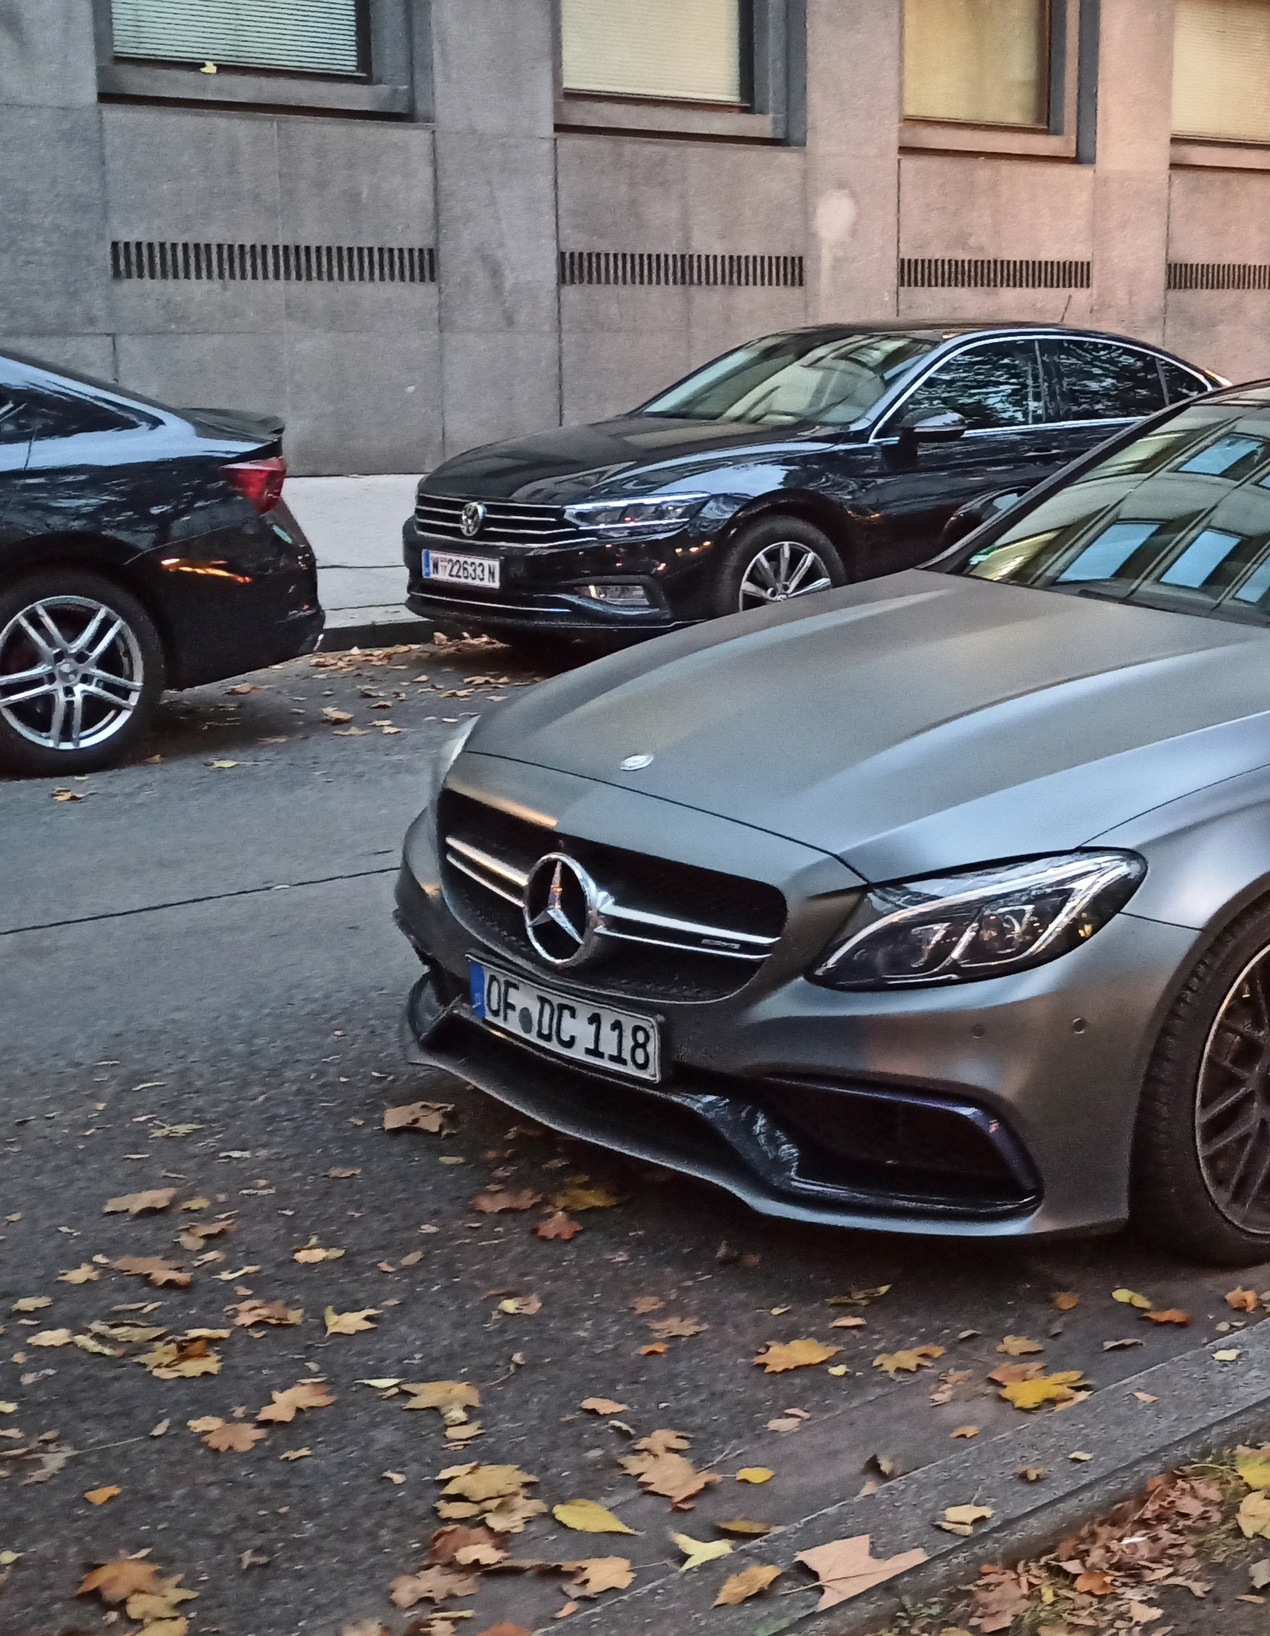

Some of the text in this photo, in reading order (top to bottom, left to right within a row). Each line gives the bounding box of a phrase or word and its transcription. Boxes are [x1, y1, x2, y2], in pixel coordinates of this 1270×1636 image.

[448, 559, 485, 581] 22633
[486, 974, 650, 1070] OF DC 118
